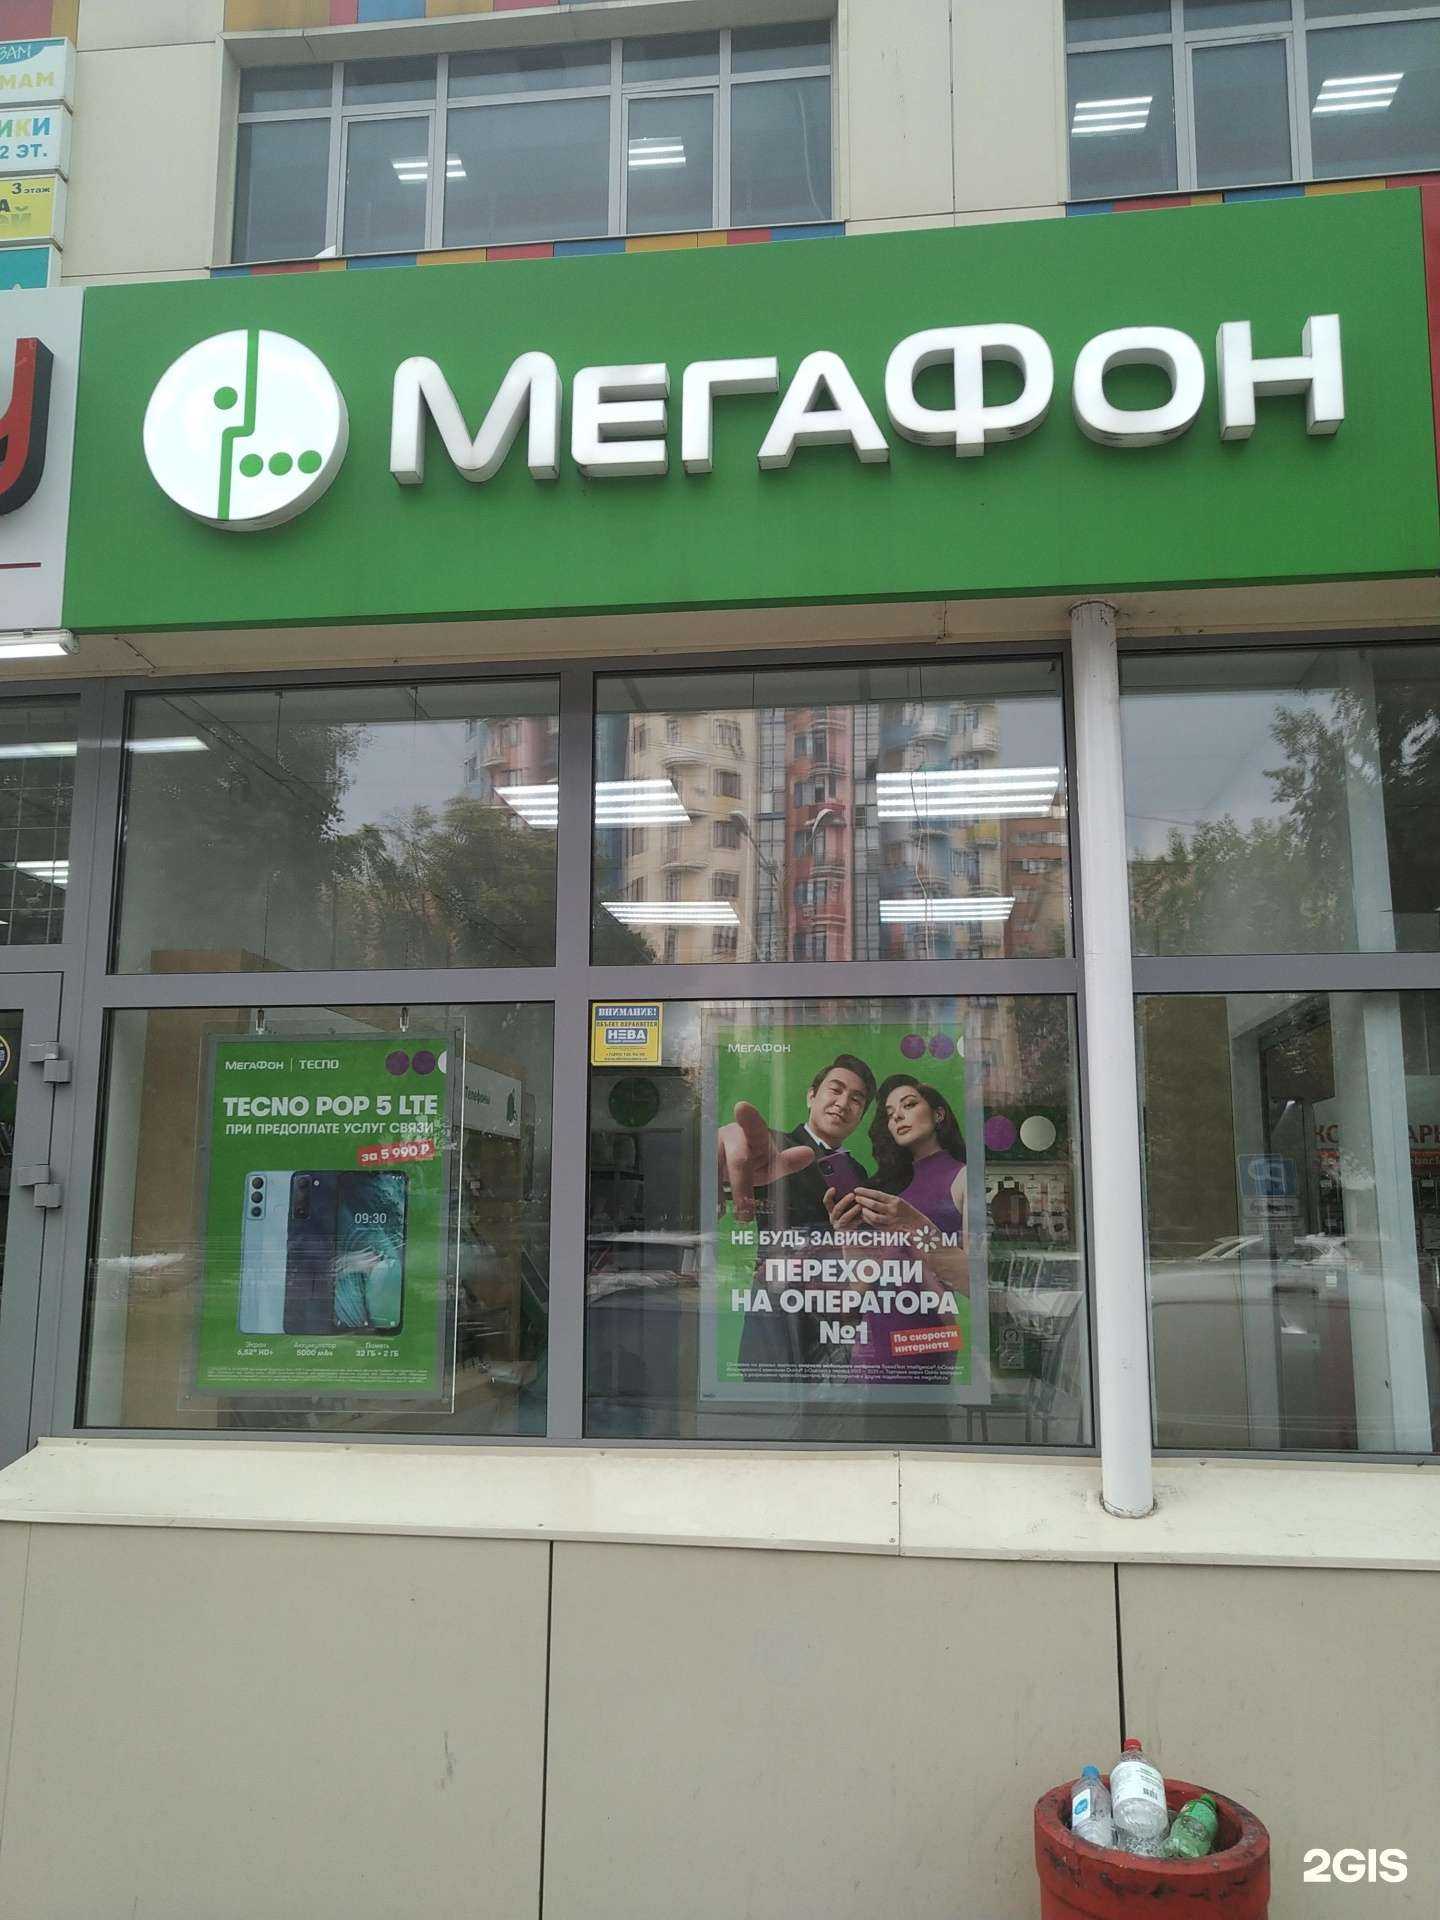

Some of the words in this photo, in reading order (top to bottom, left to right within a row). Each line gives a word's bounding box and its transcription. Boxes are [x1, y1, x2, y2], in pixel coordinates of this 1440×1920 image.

[16, 144, 48, 159] ЭТ.
[11, 182, 22, 195] 3
[23, 186, 51, 194] этаж
[599, 1007, 657, 1016] ВНИМАНИЕ!
[607, 1029, 646, 1040] НЕВА
[222, 1097, 309, 1118] TECNO
[316, 1096, 370, 1116] POP
[375, 1095, 392, 1116] 5
[399, 1094, 437, 1115] LTE
[225, 1123, 252, 1135] ПРИ
[255, 1123, 340, 1137] ПРЕДОПЛАТЕ
[344, 1122, 386, 1135] УСЛУГ
[389, 1121, 434, 1134] СВЯЗИ
[361, 1152, 377, 1162] за
[354, 1212, 387, 1225] 09:30
[731, 1230, 753, 1246] НЕ
[759, 1231, 806, 1248] БУДЬ
[765, 1258, 923, 1287] ПЕРЕХОДИ
[731, 1289, 773, 1312] НА
[779, 1290, 960, 1315] ОПЕРАТОРА
[819, 1320, 869, 1345] №1
[894, 1333, 908, 1343] По
[909, 1329, 958, 1342] скорости
